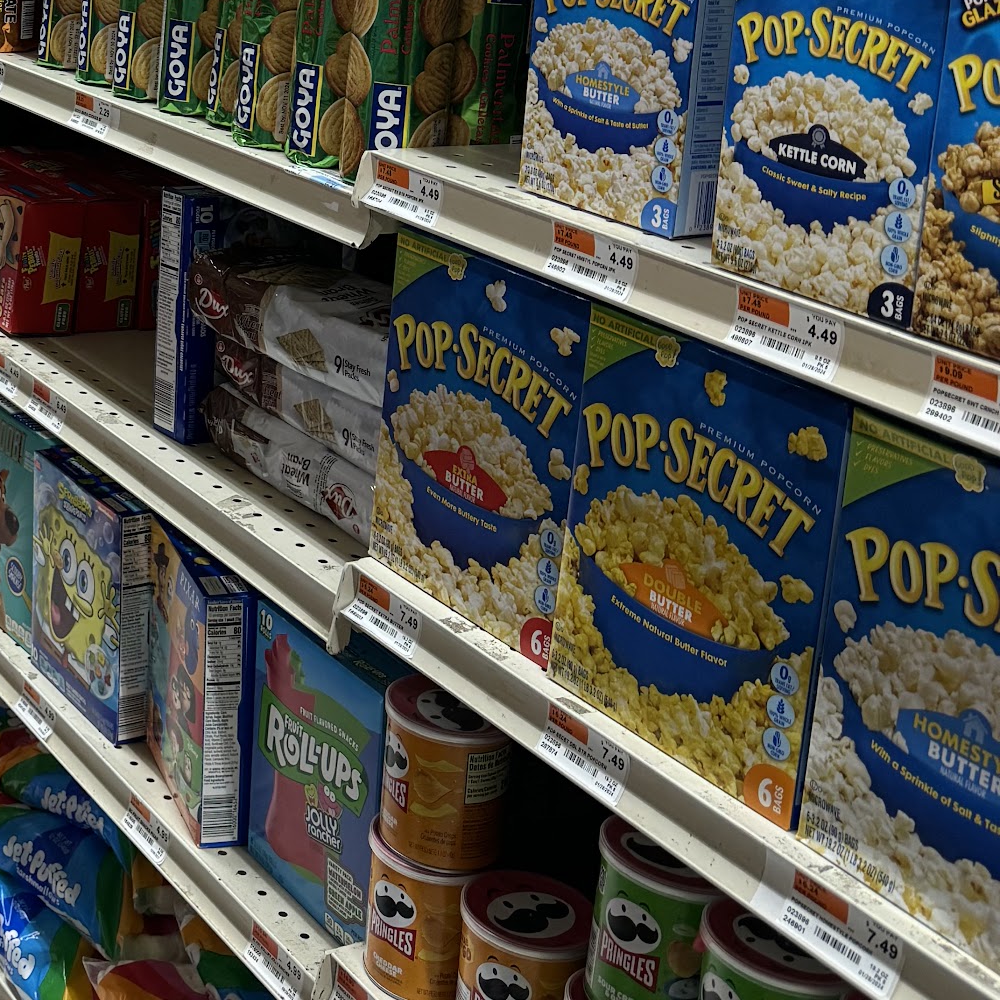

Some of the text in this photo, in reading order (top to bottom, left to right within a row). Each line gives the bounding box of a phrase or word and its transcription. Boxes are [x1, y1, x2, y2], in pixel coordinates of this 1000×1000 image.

[837, 6, 936, 55] PREMIUM POPCORN
[114, 15, 131, 84] GOYA
[167, 25, 189, 96] GOYA
[237, 47, 255, 124] GOYA
[575, 74, 630, 98] HOMESTYLE
[583, 87, 620, 106] BUTTER
[293, 68, 316, 149] GOYA
[779, 143, 857, 175] KETTLE CORN
[421, 185, 439, 201] 4.49
[762, 165, 867, 202] Classic Sweet Salty Recipe
[651, 204, 670, 231] 3 BAGS
[609, 252, 633, 271] 4.49
[195, 287, 229, 319] Dux
[881, 290, 905, 321] 3 BAGS
[808, 324, 837, 345] 4.49
[344, 361, 371, 377] Stay Fresh
[925, 407, 953, 423] 299402
[929, 398, 956, 413] 023896
[445, 470, 484, 502] BUTTER
[452, 464, 477, 486] EXTRA
[643, 573, 703, 614] DOUBLE
[649, 590, 692, 623] BUTTER
[207, 625, 241, 637] Calories 80
[260, 609, 273, 628] 10
[400, 611, 418, 630] 7.49
[610, 595, 727, 668] Extreme Natural Butter Flavor
[531, 630, 543, 656] 6
[267, 703, 363, 801] ROLL-UPS
[602, 746, 625, 770] 7.49
[757, 778, 784, 815] 6 BAGS
[306, 805, 339, 835] JOLLY
[307, 823, 341, 848] rancher
[2, 835, 81, 907] Jet-Puffed
[371, 913, 413, 955] PRINGLES
[867, 929, 898, 959] 7.49
[600, 930, 656, 988] PRINGLES
